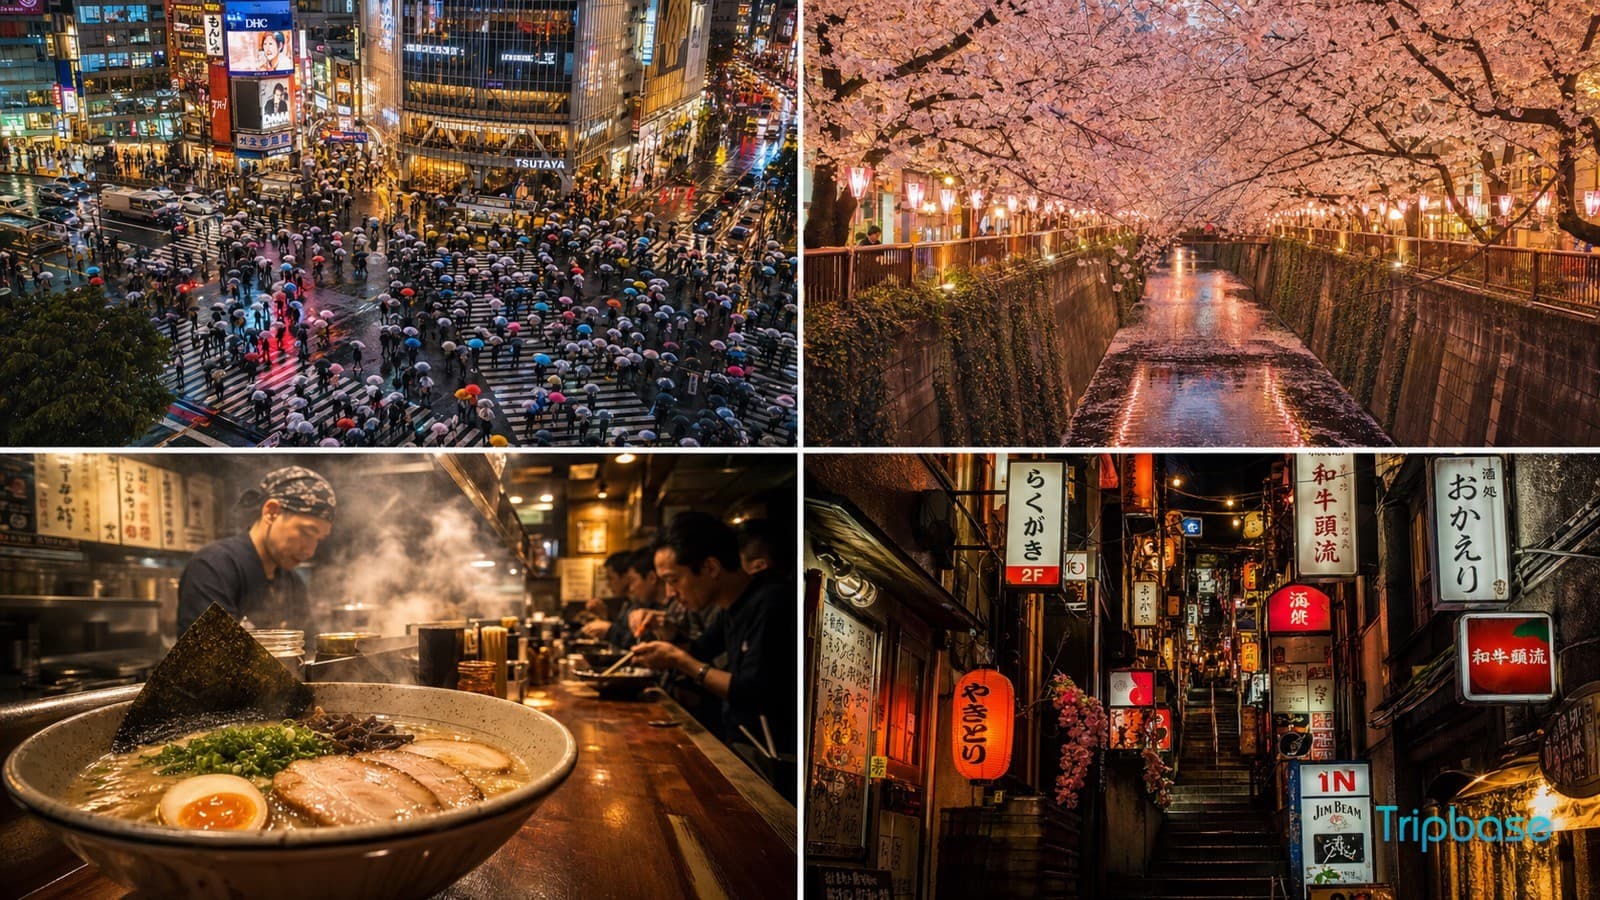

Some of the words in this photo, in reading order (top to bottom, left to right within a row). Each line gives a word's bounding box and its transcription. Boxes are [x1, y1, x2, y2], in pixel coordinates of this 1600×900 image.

[245, 18, 268, 28] DHC
[515, 158, 565, 169] TSUTAYA
[1482, 467, 1497, 498] 酒処
[1023, 468, 1045, 561] らくがき
[1312, 463, 1340, 564] 和牛頭流
[1448, 473, 1482, 593] おかえり
[1021, 568, 1044, 582] 2F
[1471, 647, 1547, 666] 和牛頭流
[961, 682, 990, 765] やきとり
[1313, 804, 1332, 820] JIM
[1334, 801, 1362, 820] BEAM
